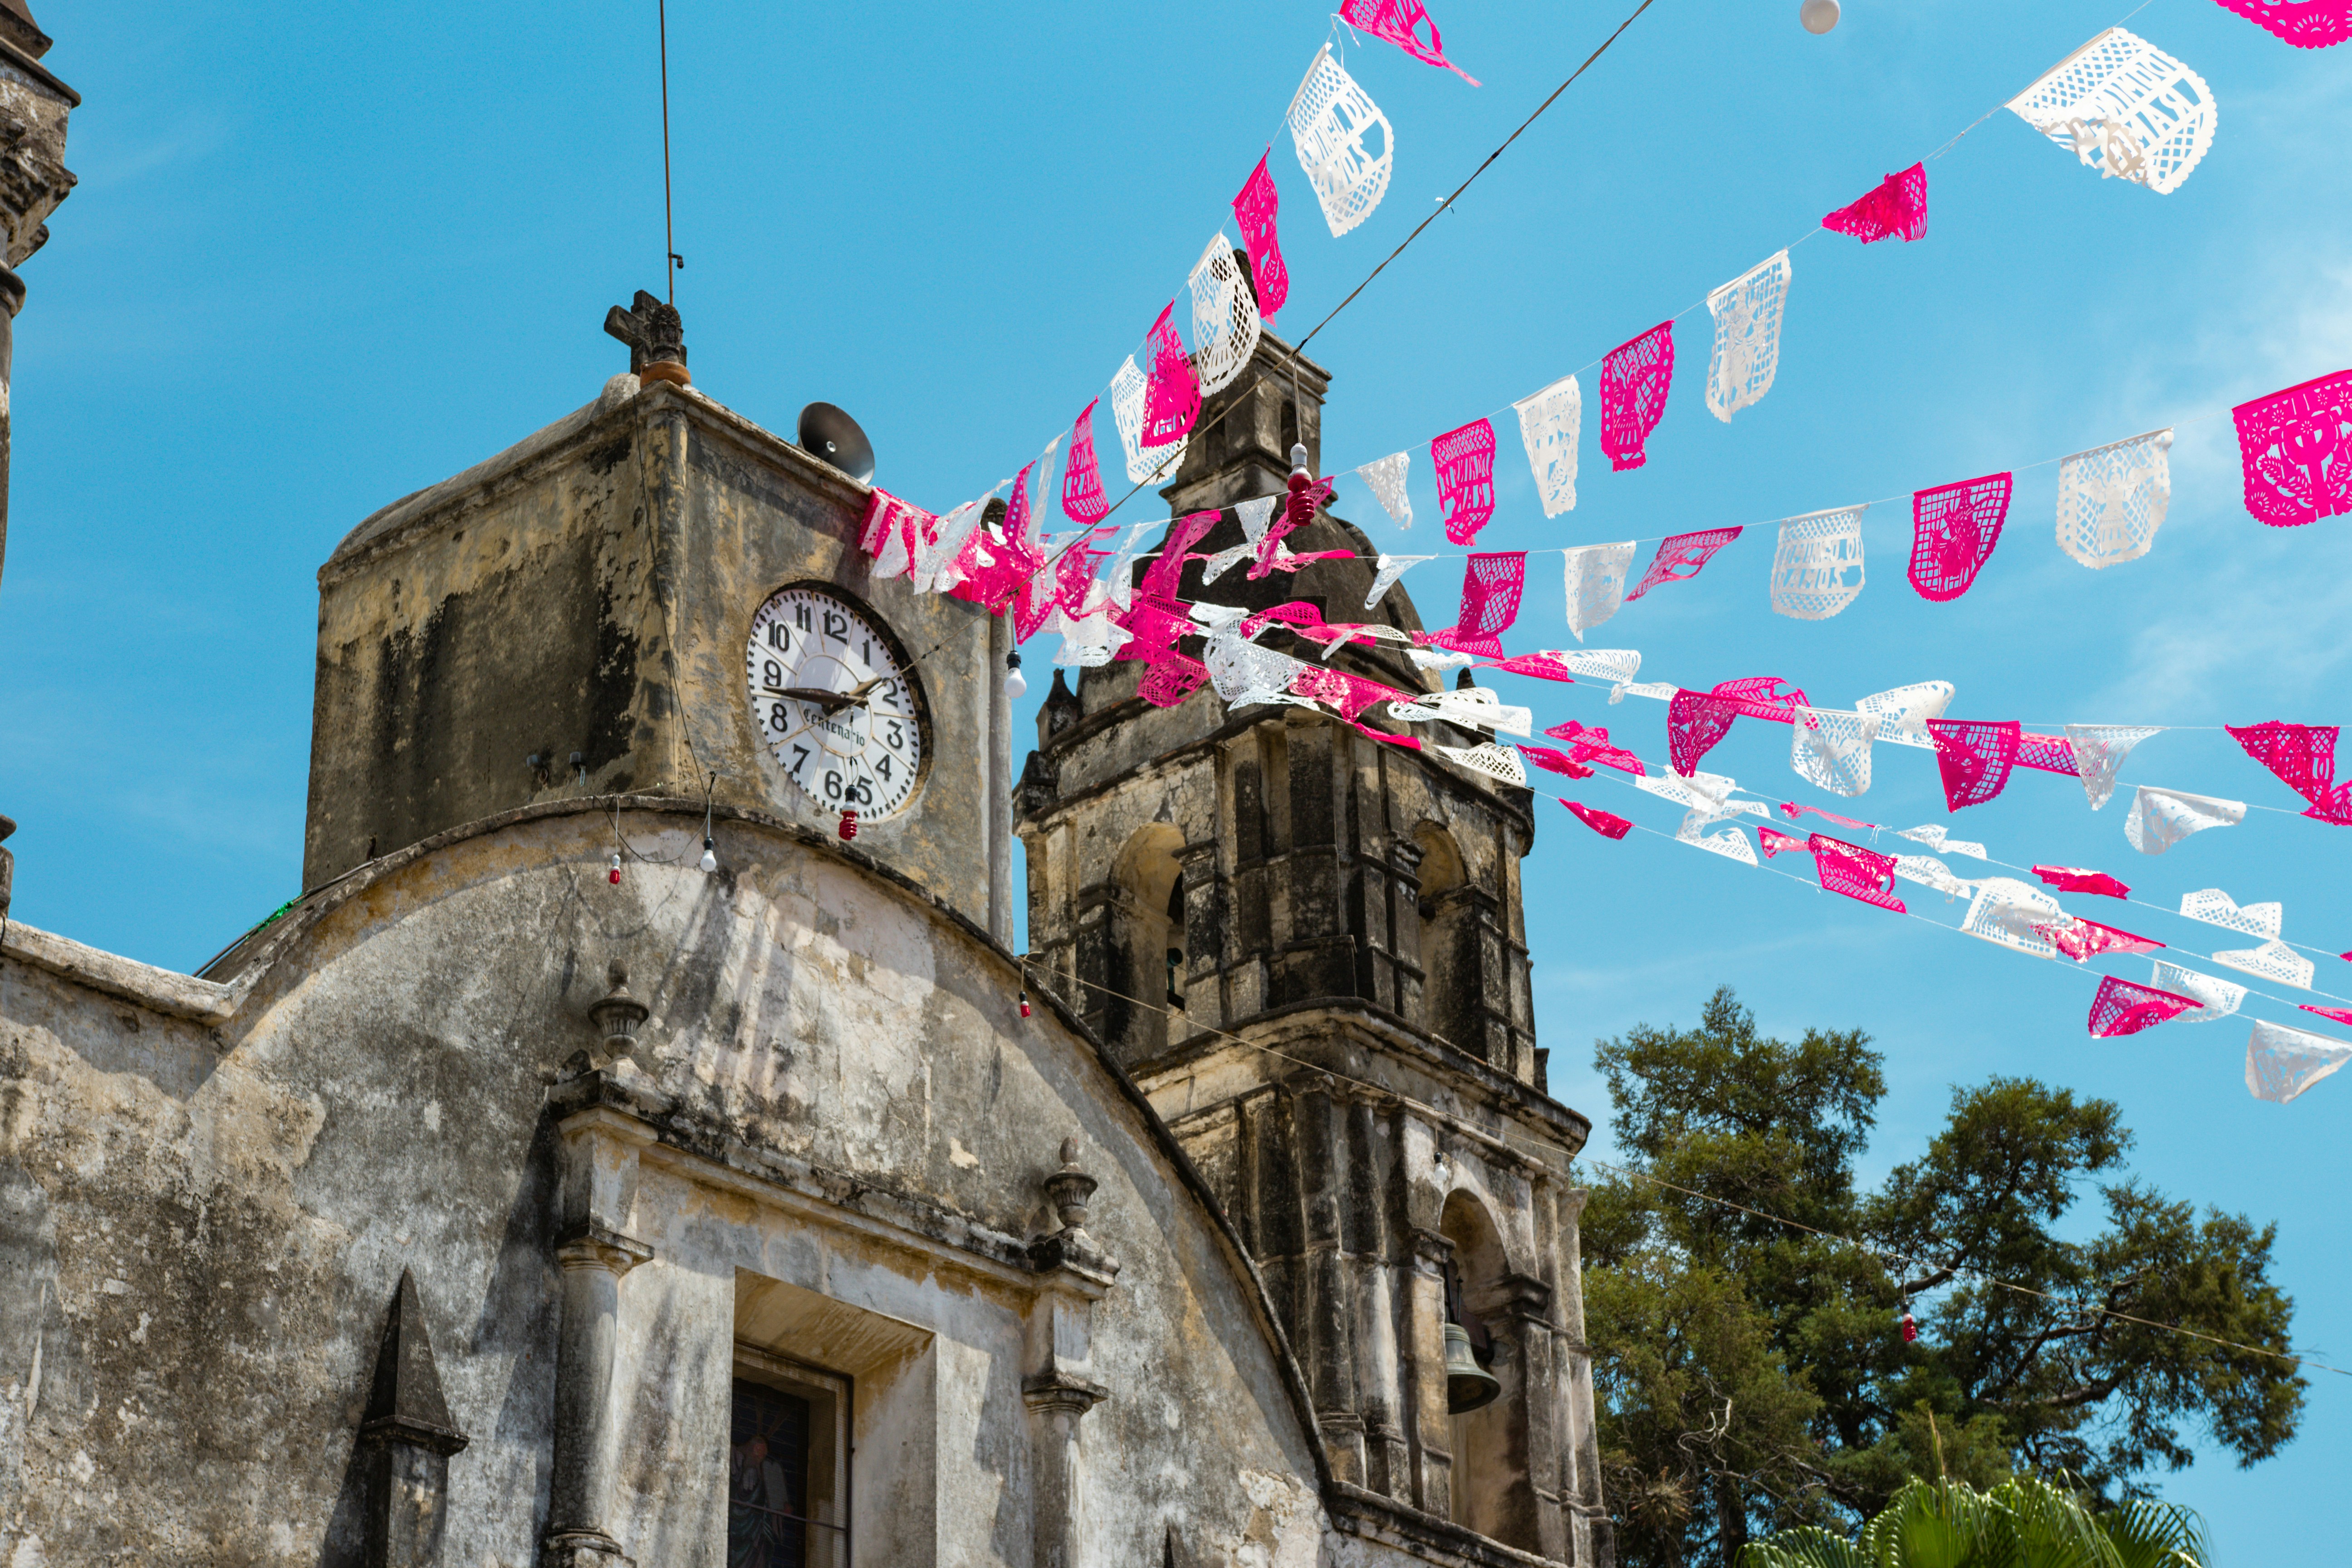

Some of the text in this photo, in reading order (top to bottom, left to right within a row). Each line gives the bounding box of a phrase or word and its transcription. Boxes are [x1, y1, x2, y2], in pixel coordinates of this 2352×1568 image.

[1775, 565, 1847, 590] RAMOS
[795, 602, 812, 634] 11
[823, 609, 848, 645] 12
[768, 619, 789, 652] 10
[862, 639, 871, 667] 1
[764, 659, 781, 687] 9
[882, 676, 898, 708] 2
[770, 702, 788, 733] 8
[804, 708, 865, 747] Centenario
[887, 719, 903, 749] 3
[793, 743, 810, 774] 7
[875, 754, 892, 782] 4
[825, 770, 843, 799] 6
[857, 775, 873, 805] 5
